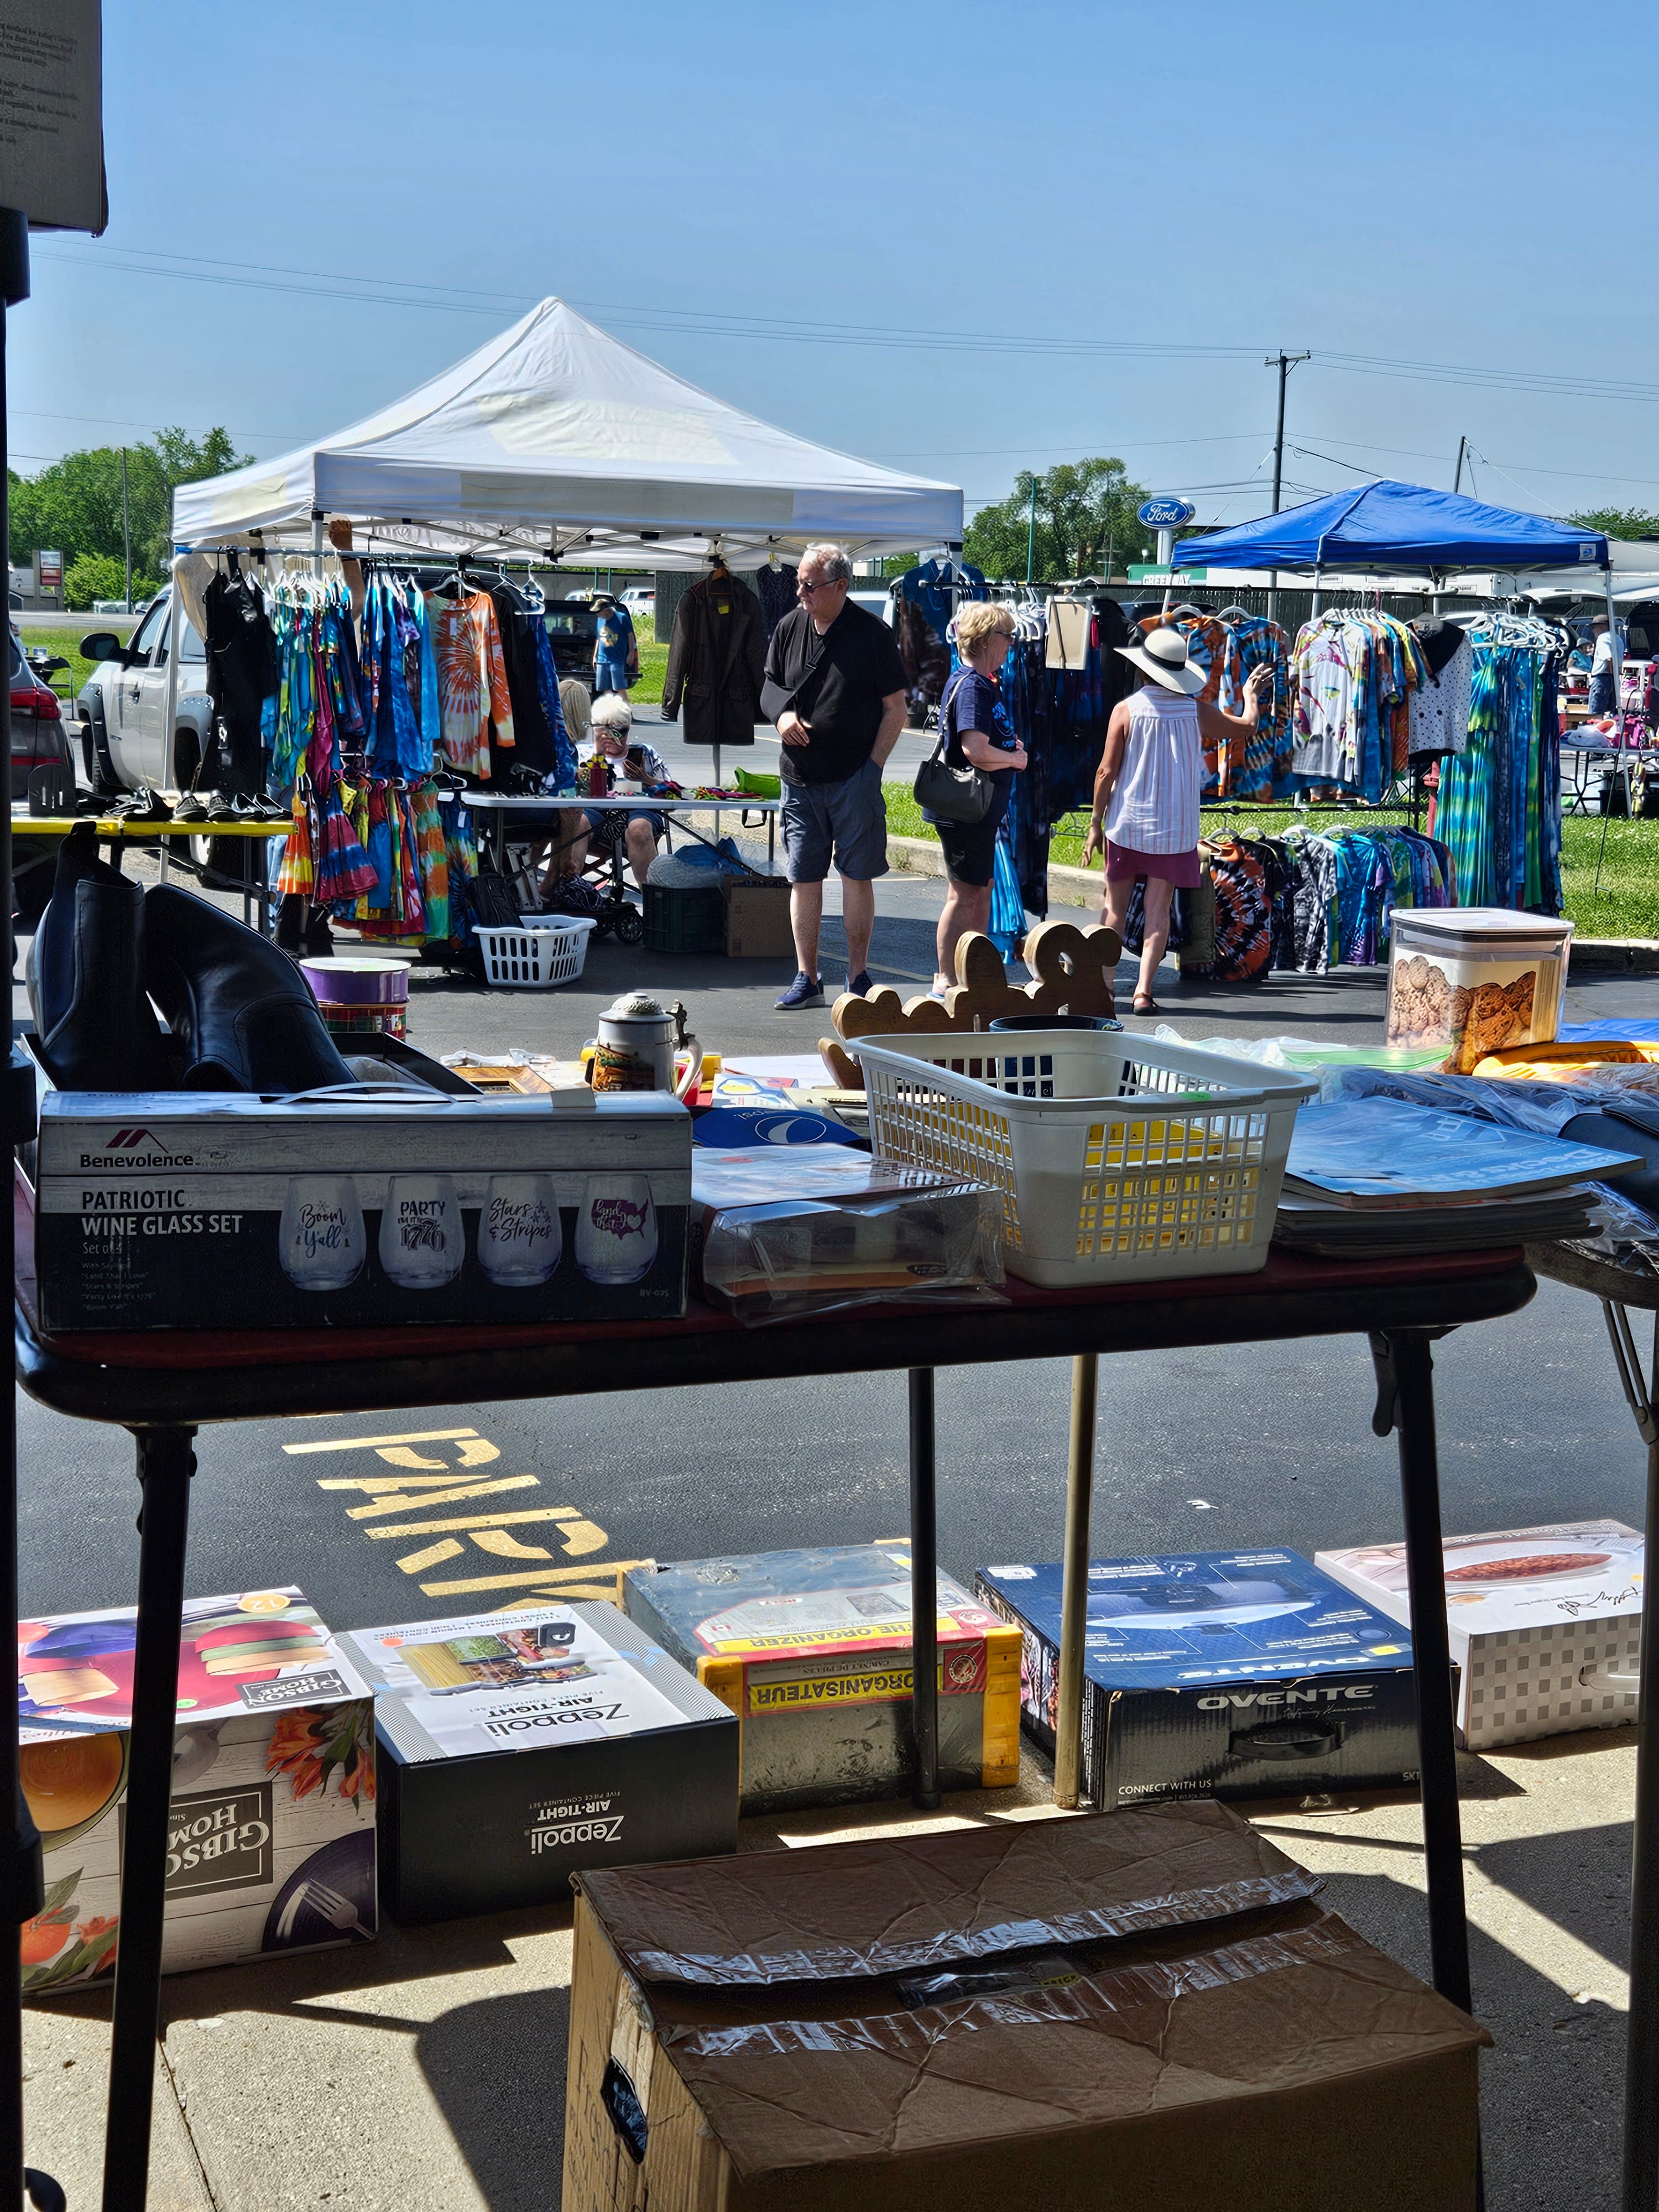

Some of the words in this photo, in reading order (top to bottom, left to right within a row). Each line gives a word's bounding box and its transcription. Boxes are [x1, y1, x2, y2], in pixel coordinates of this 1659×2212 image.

[1147, 503, 1178, 521] Ford
[80, 1153, 194, 1168] Benevolence
[82, 1190, 185, 1209] PATRIOTIC
[401, 1201, 445, 1216] PARTY
[489, 1198, 534, 1222] Stars
[81, 1217, 137, 1236] WINE
[143, 1215, 204, 1235] GLASS
[209, 1215, 243, 1234] SET
[299, 1203, 346, 1229] Boom
[401, 1217, 446, 1253] 1776
[500, 1218, 552, 1247] Stripes
[83, 1243, 99, 1254] Set
[252, 1599, 278, 1611] 12
[1177, 1657, 1370, 1679] OVENTE
[247, 1679, 342, 1707] GIBSON
[260, 1676, 316, 1696] HOME
[488, 1697, 593, 1718] AIR-TIGHT
[1197, 1685, 1376, 1710] OVENTE
[484, 1703, 630, 1737] Zeppoli
[1118, 1783, 1167, 1795] CONNECT
[1170, 1781, 1196, 1790] WITH
[1199, 1779, 1212, 1788] US
[531, 1815, 624, 1855] Zeppoli
